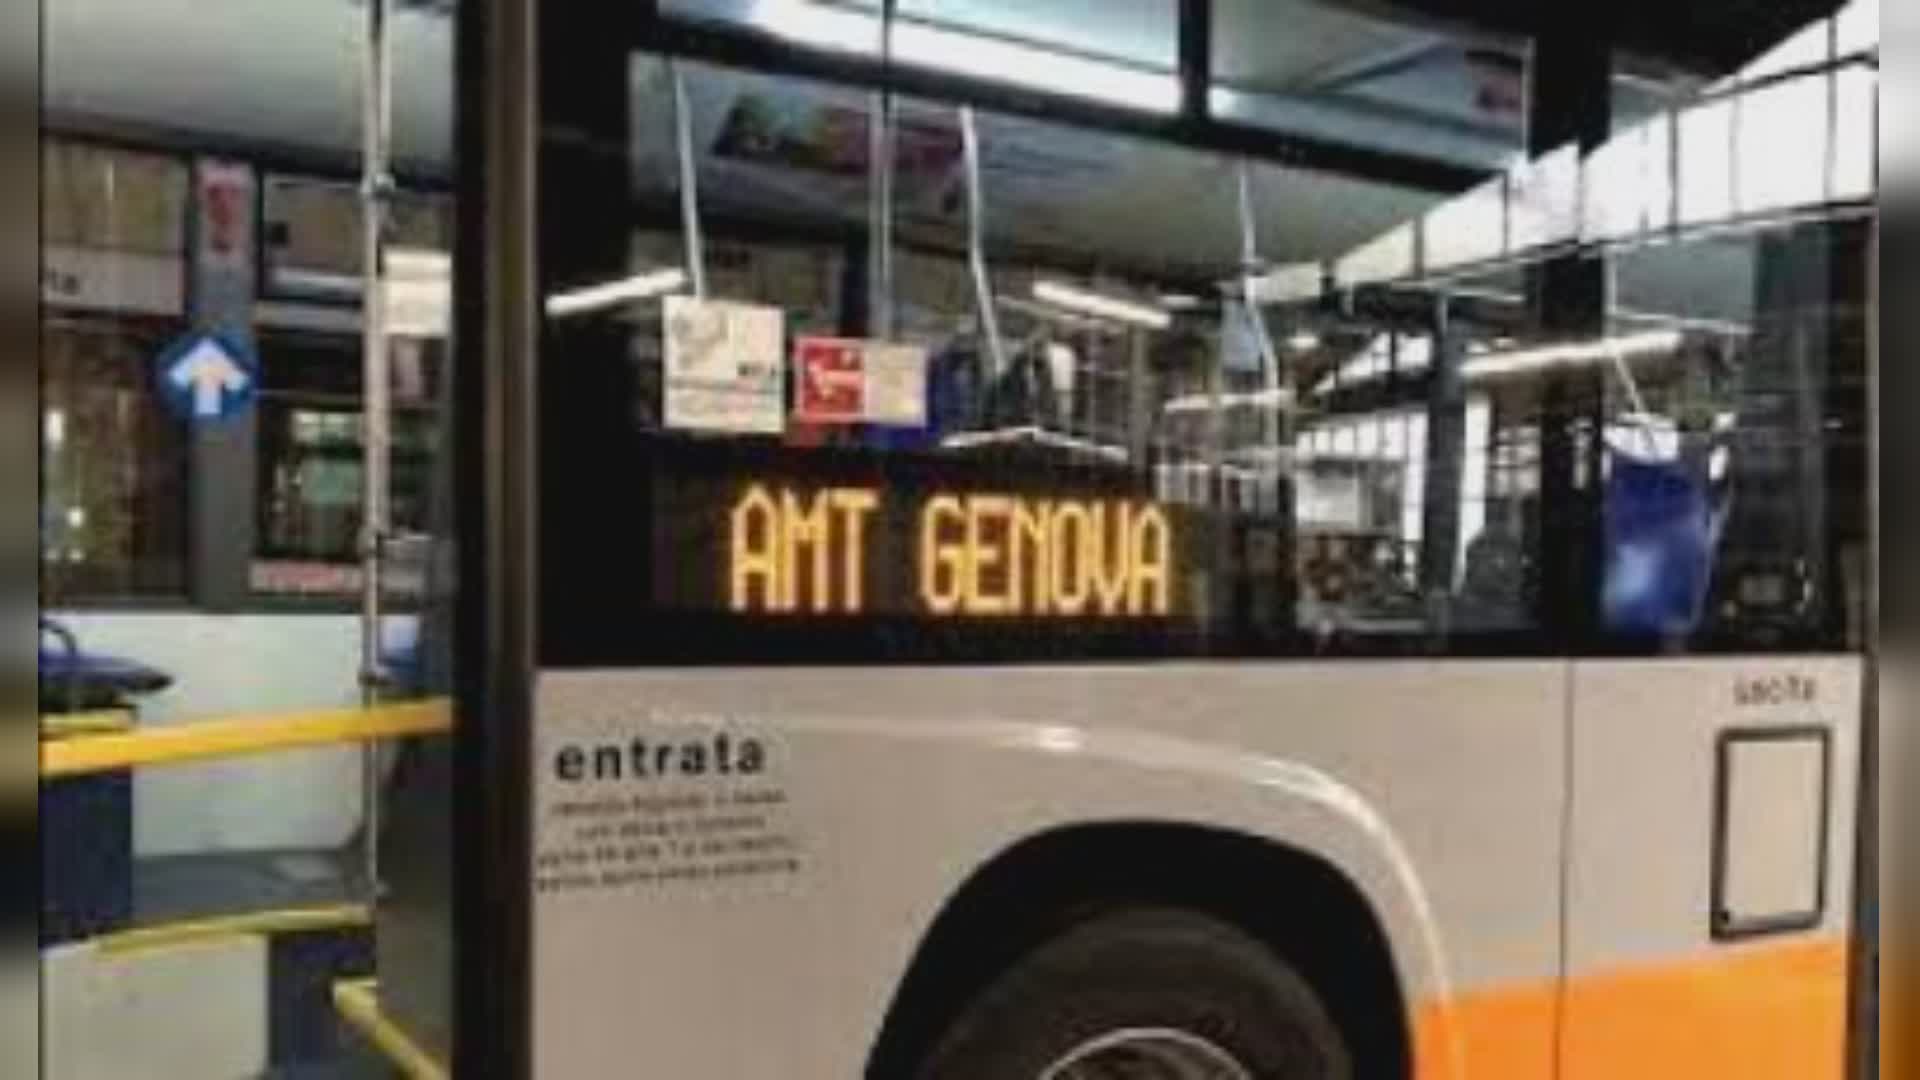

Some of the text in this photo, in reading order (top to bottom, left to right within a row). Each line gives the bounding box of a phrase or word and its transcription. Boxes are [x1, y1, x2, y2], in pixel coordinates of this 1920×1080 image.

[729, 483, 1173, 615] AMT GENOVA
[554, 731, 767, 783] entrata
